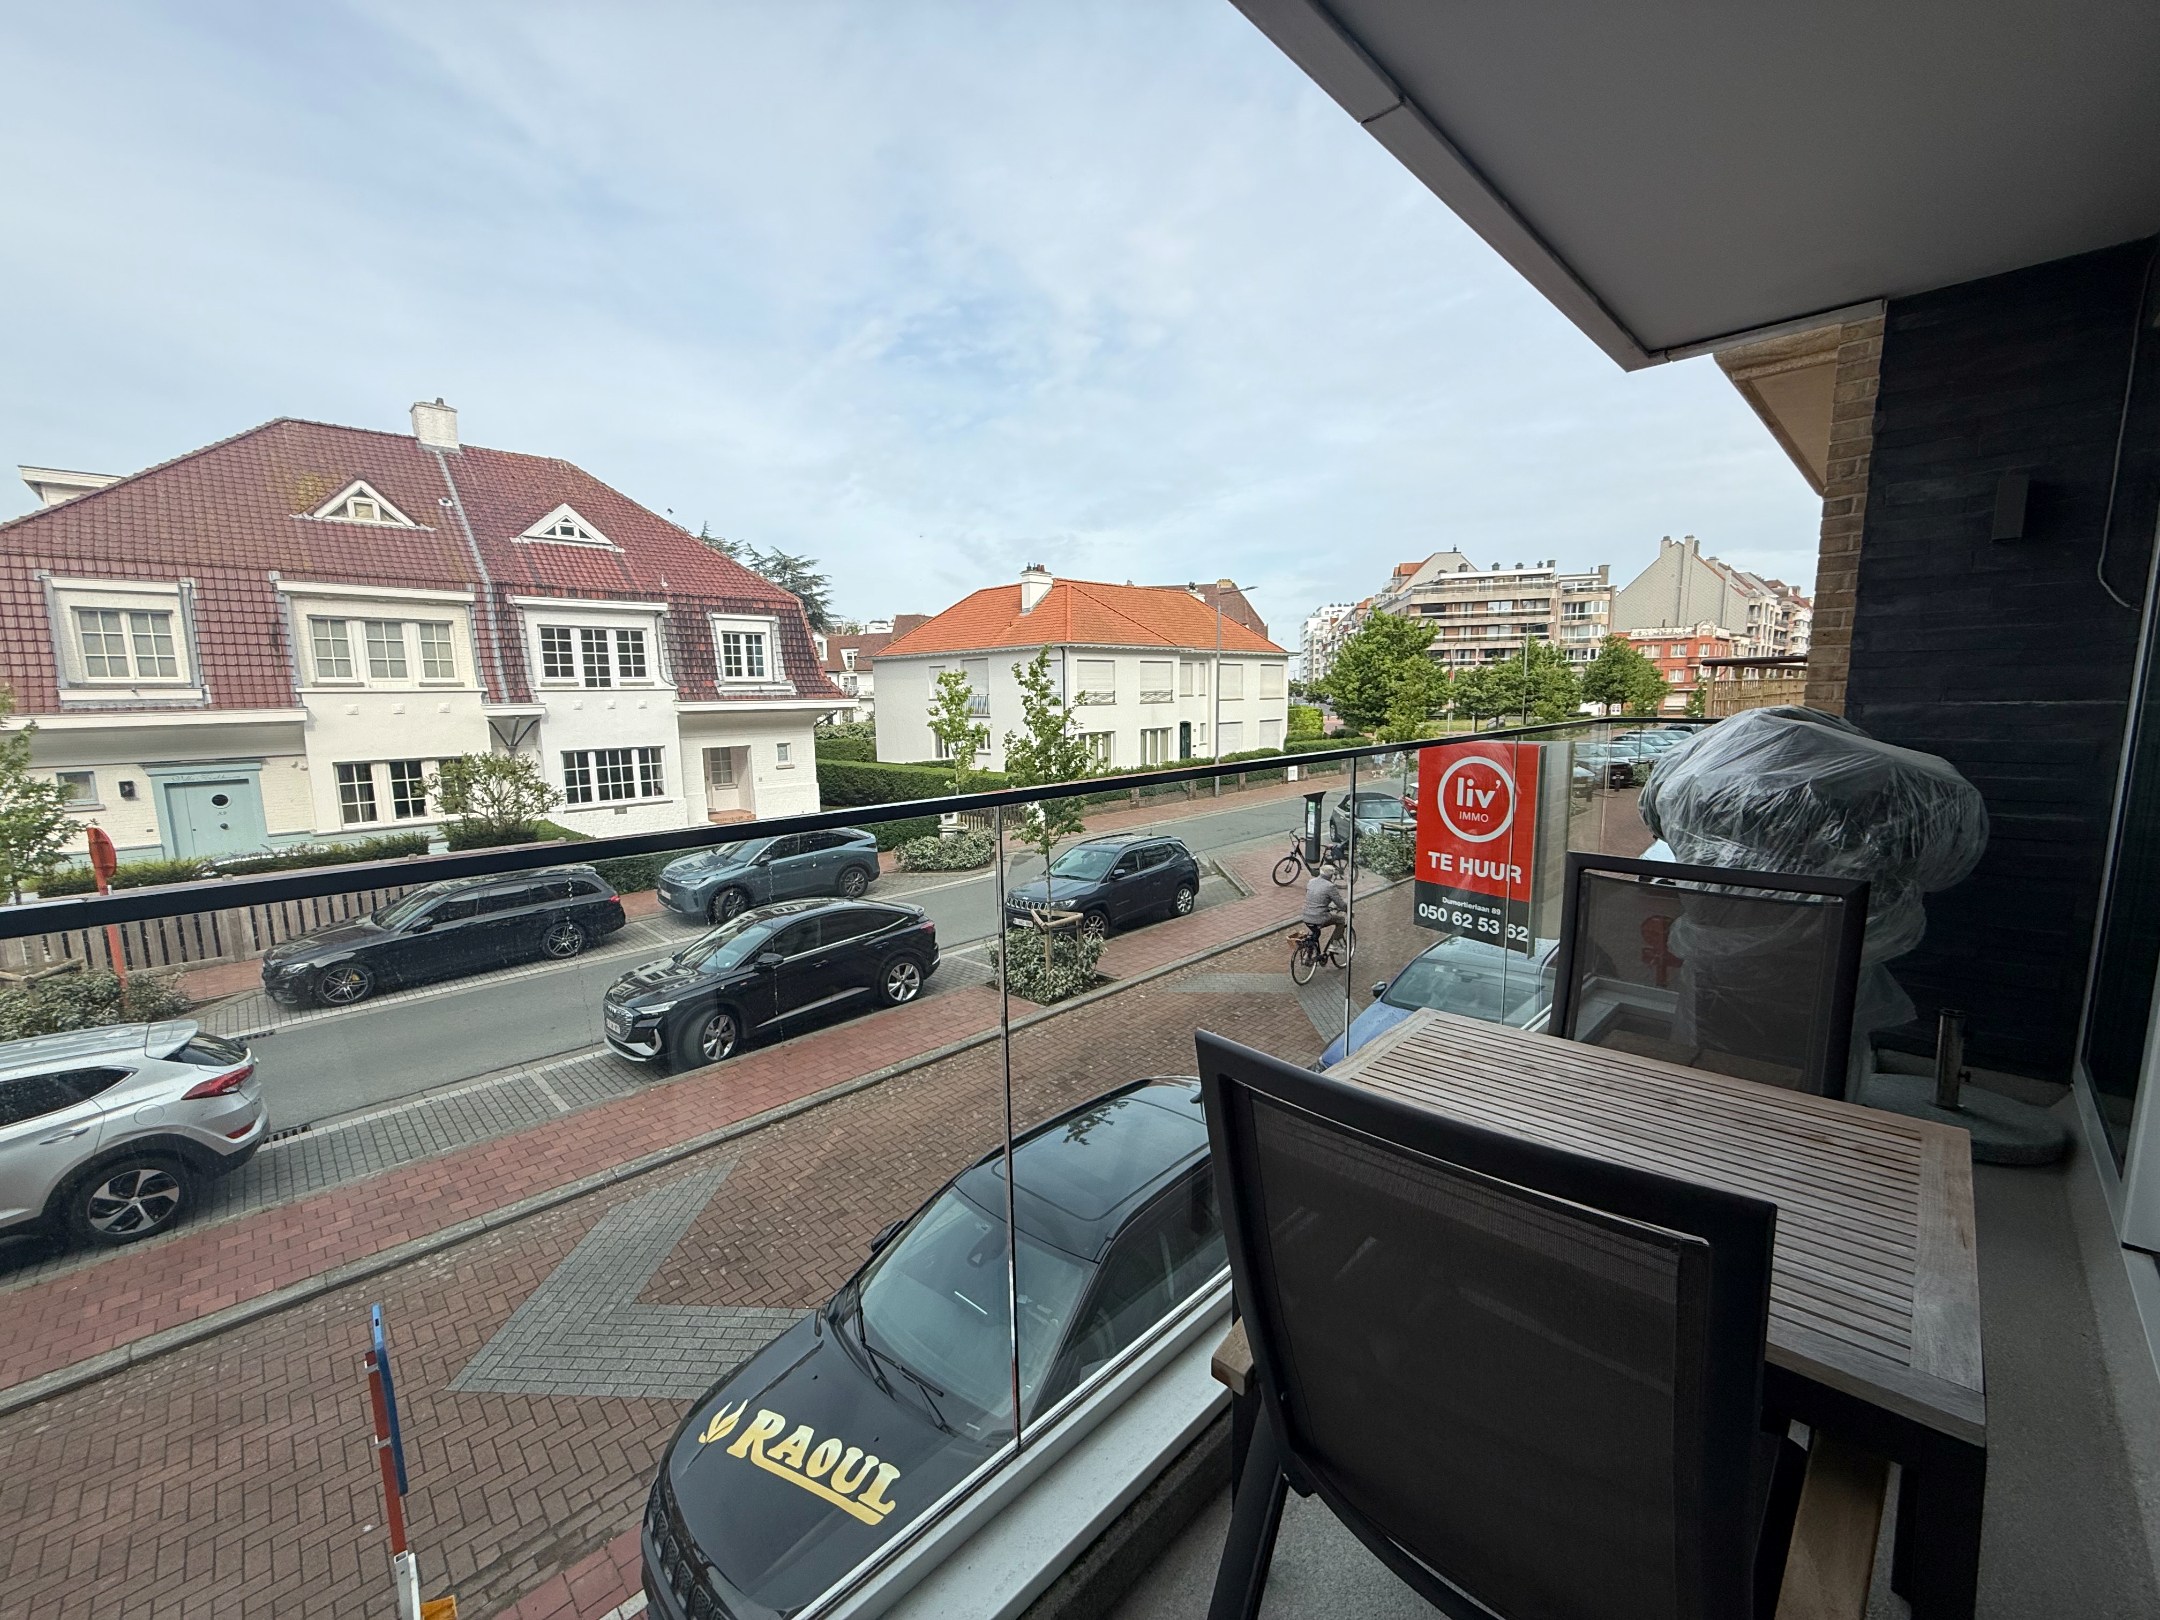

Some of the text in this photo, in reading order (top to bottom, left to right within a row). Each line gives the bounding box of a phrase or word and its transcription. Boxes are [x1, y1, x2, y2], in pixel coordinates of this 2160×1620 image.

[1459, 811, 1489, 823] IMMO
[1428, 851, 1522, 884] TE HUUR
[1418, 903, 1529, 942] 050 62 53 62
[726, 1408, 901, 1526] RAOUL
